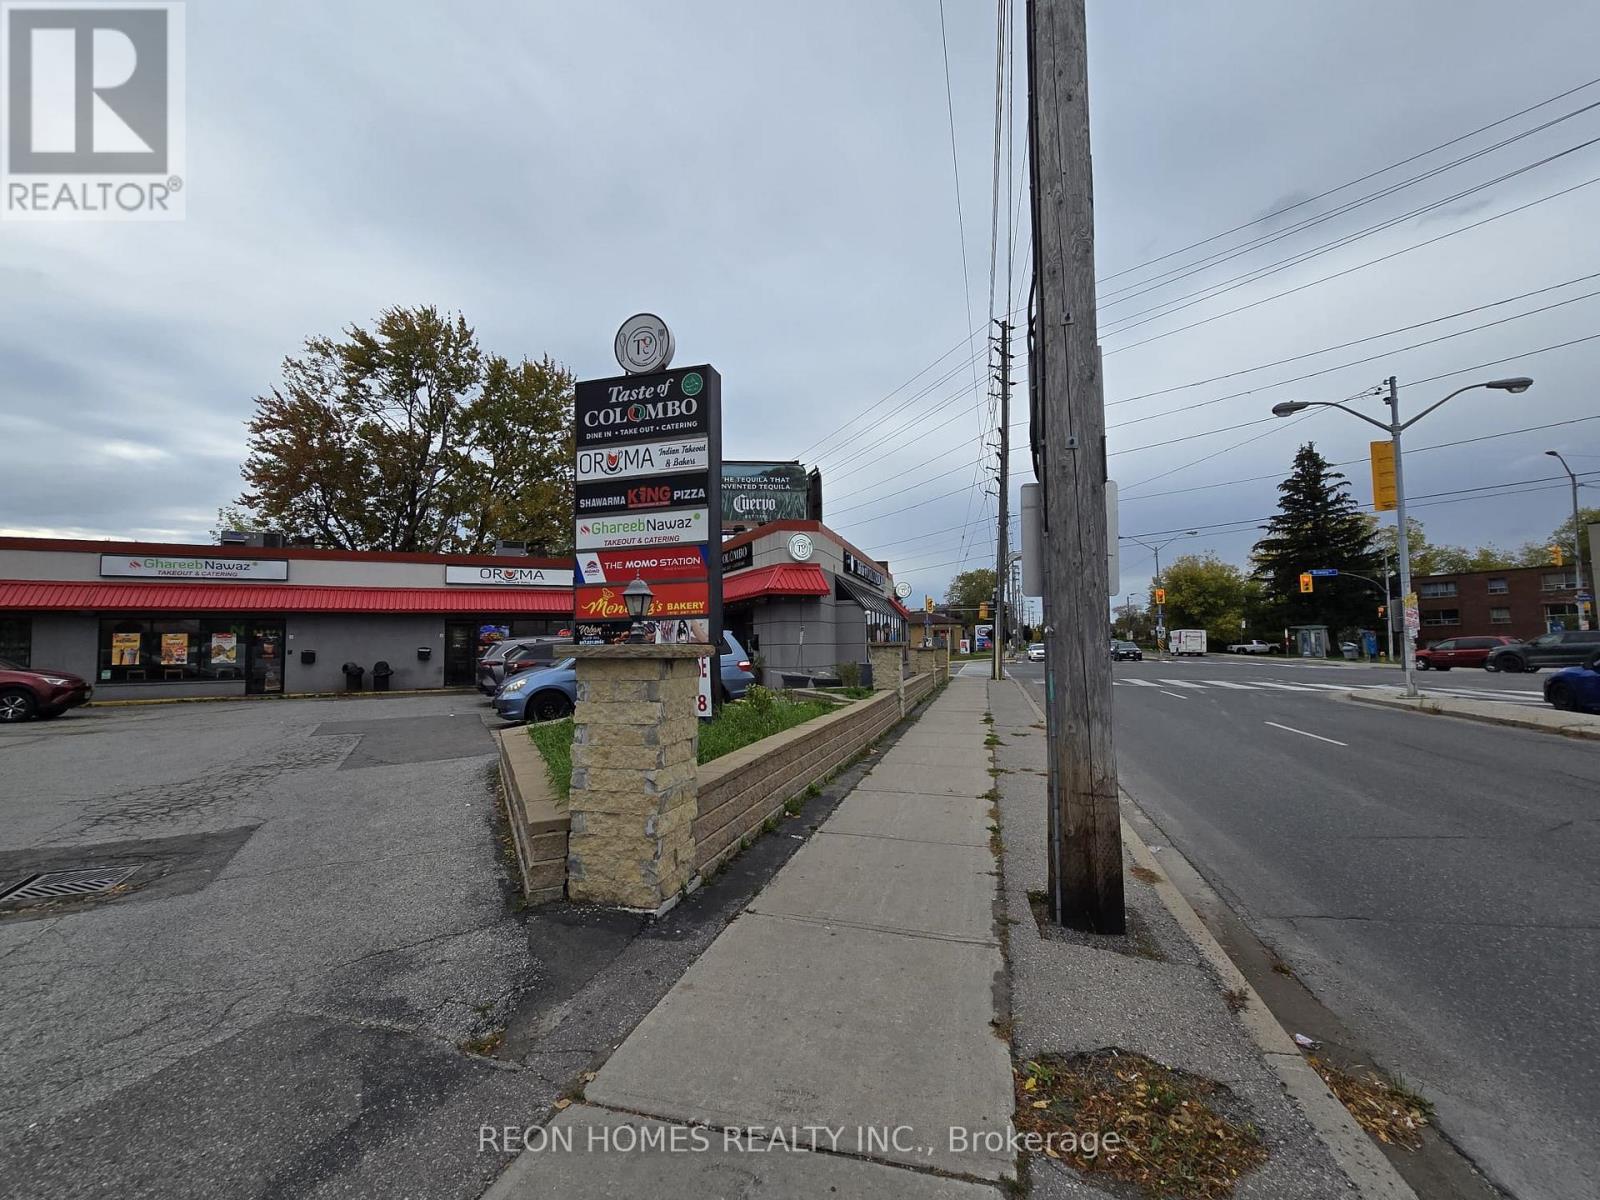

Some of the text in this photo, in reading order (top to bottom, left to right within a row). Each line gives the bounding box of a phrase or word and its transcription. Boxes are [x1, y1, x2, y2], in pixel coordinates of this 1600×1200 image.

[608, 384, 654, 404] Taste
[657, 378, 675, 397] of
[584, 398, 698, 427] COLOMBO
[586, 432, 602, 440] DINE
[620, 427, 638, 436] TAKE
[639, 425, 654, 433] OUT
[661, 420, 698, 431] CATERING
[658, 444, 706, 457] Indian Takeout
[665, 458, 671, 467] &
[758, 483, 791, 491] TEQUILA
[579, 495, 626, 508] SHAWARMA
[627, 486, 672, 504] KING
[673, 488, 706, 500] PIZZA
[733, 494, 776, 513] Cuervo
[604, 537, 636, 547] TAKEOUT
[644, 535, 680, 544] CATERING
[604, 561, 623, 570] THE
[625, 559, 658, 568] MOMO
[659, 556, 701, 567] STATION
[667, 601, 705, 611] BAKERY
